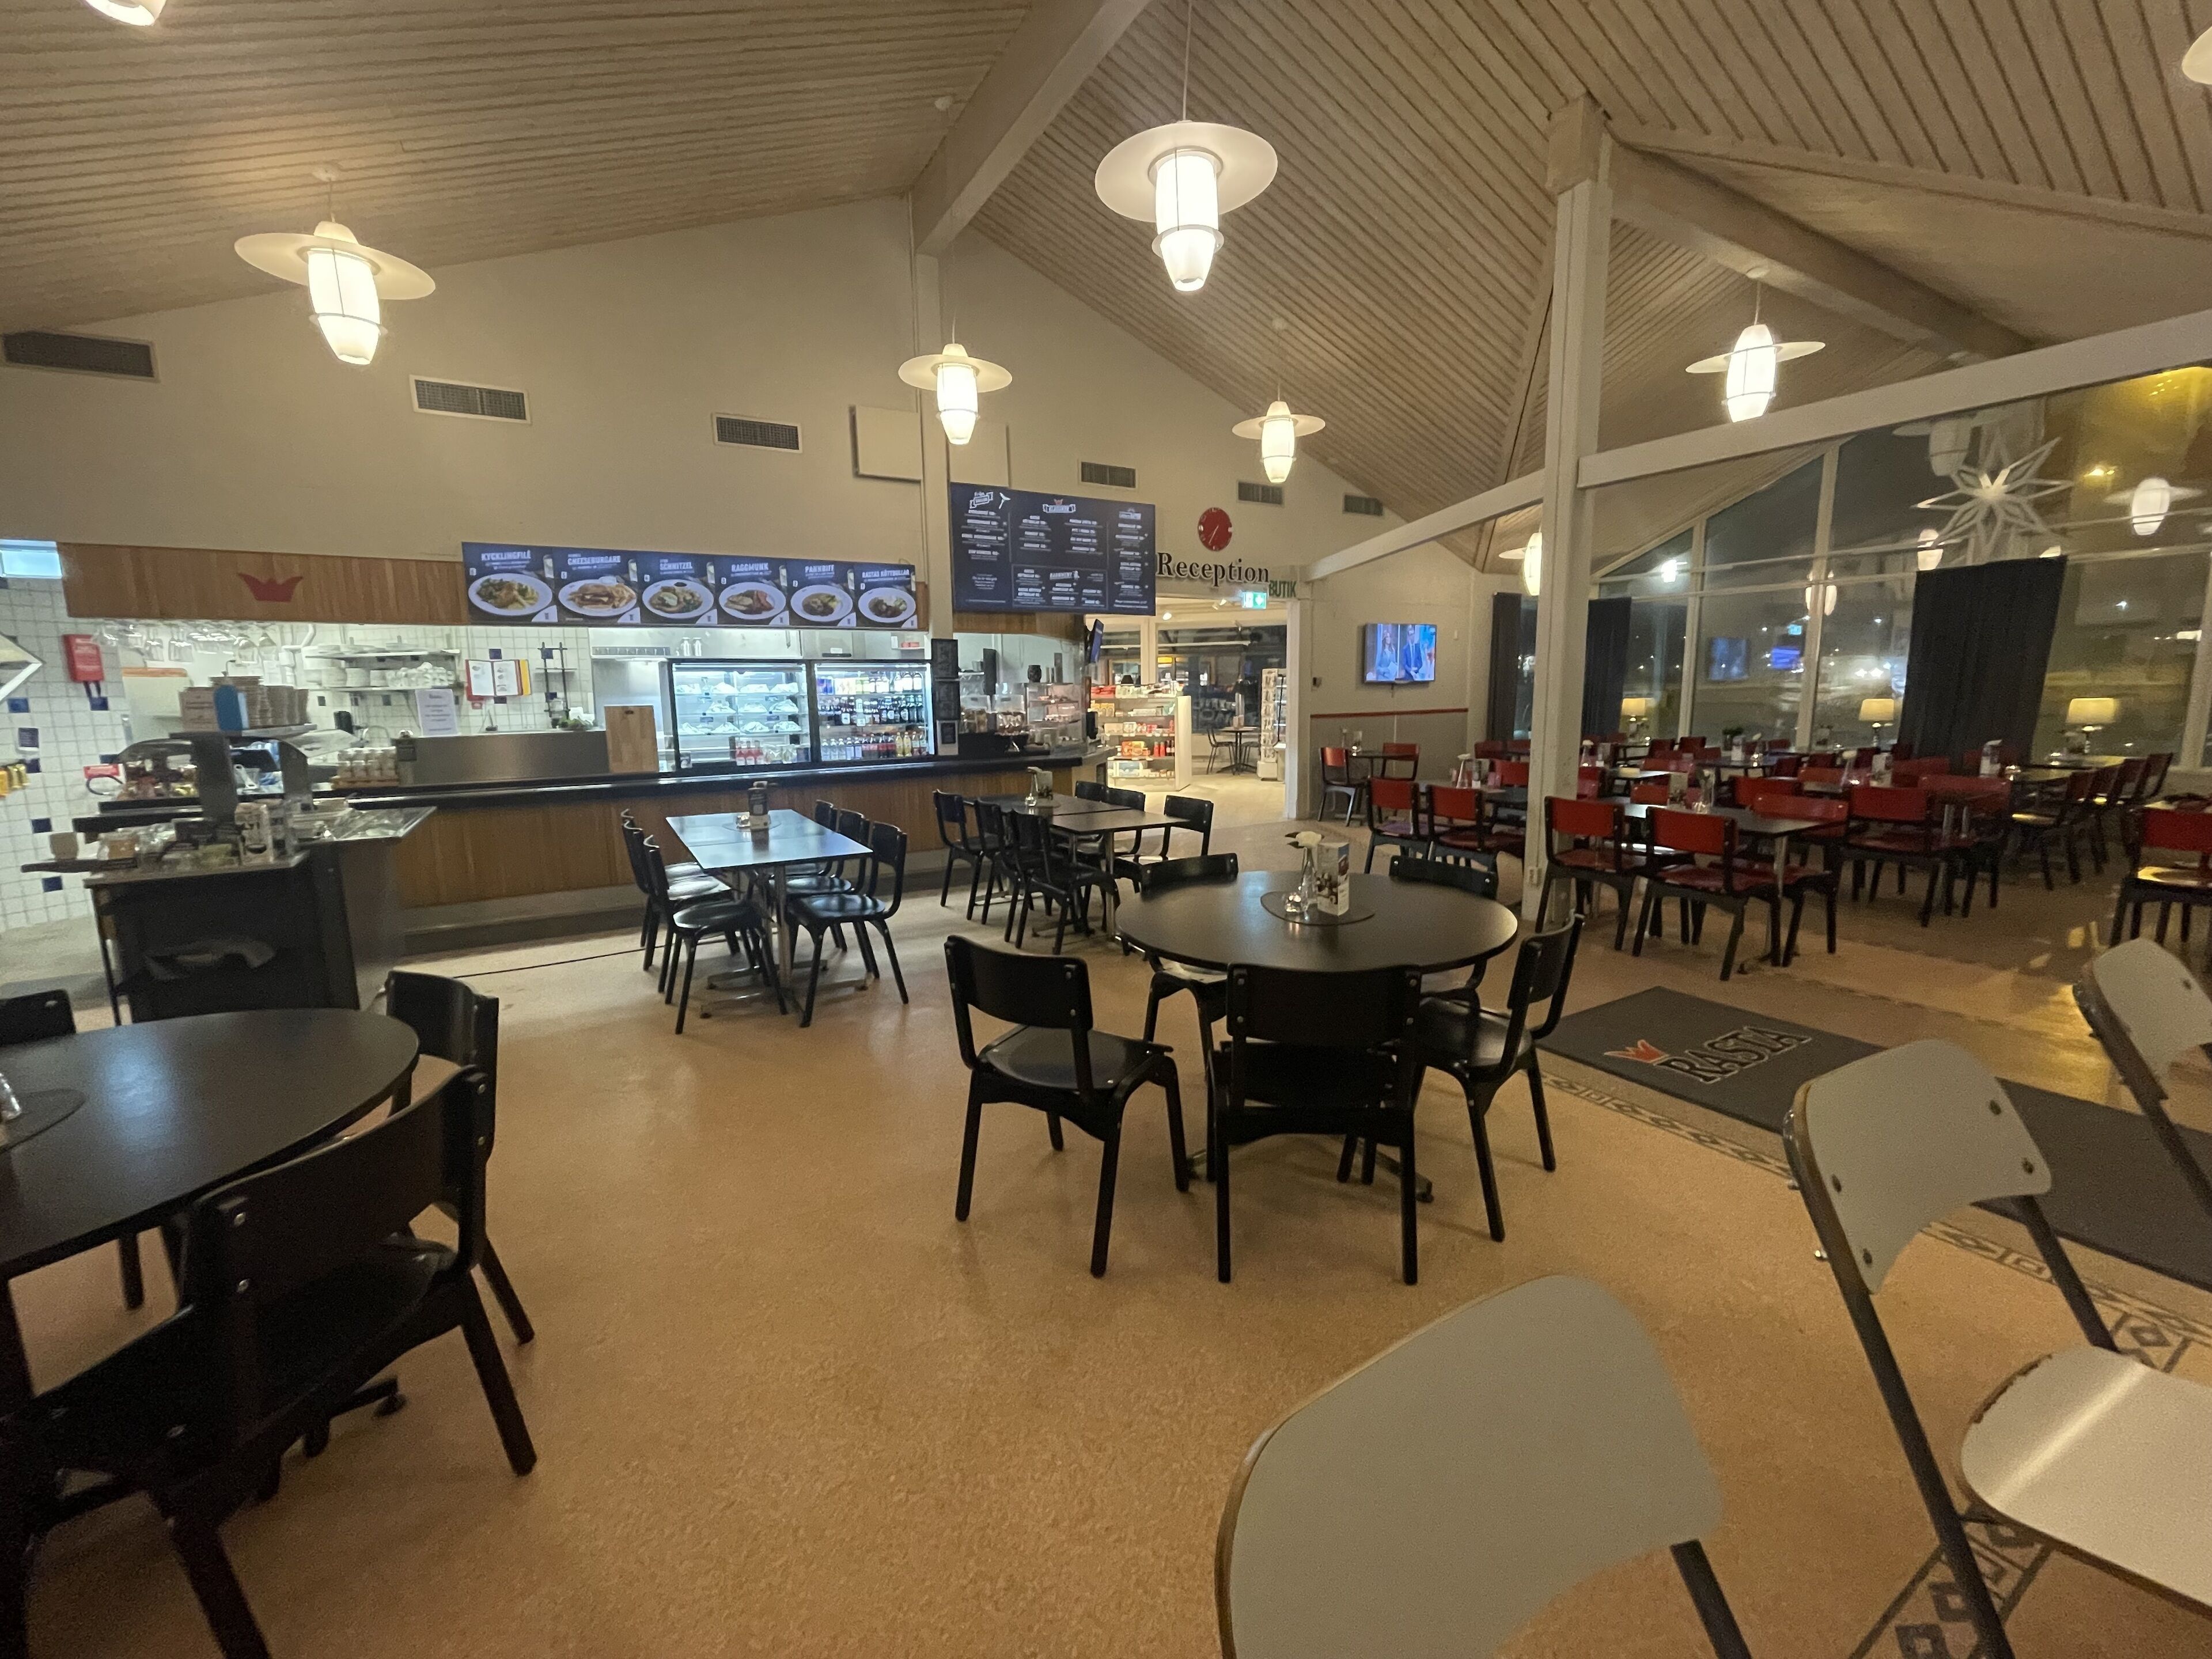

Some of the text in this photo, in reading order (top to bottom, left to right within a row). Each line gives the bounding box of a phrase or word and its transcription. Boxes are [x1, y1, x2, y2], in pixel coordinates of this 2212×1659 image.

[481, 550, 531, 560] KYCKLINGFILÉ
[567, 555, 621, 566] CHEESEBURGARE
[660, 562, 693, 570] SCHNITZEL
[731, 562, 769, 572] RAGGMUNK
[805, 564, 835, 573] PANNBIFF
[1157, 552, 1269, 586] Reception
[1269, 579, 1297, 597] BUTIK
[1654, 1027, 1812, 1084] RASTA
